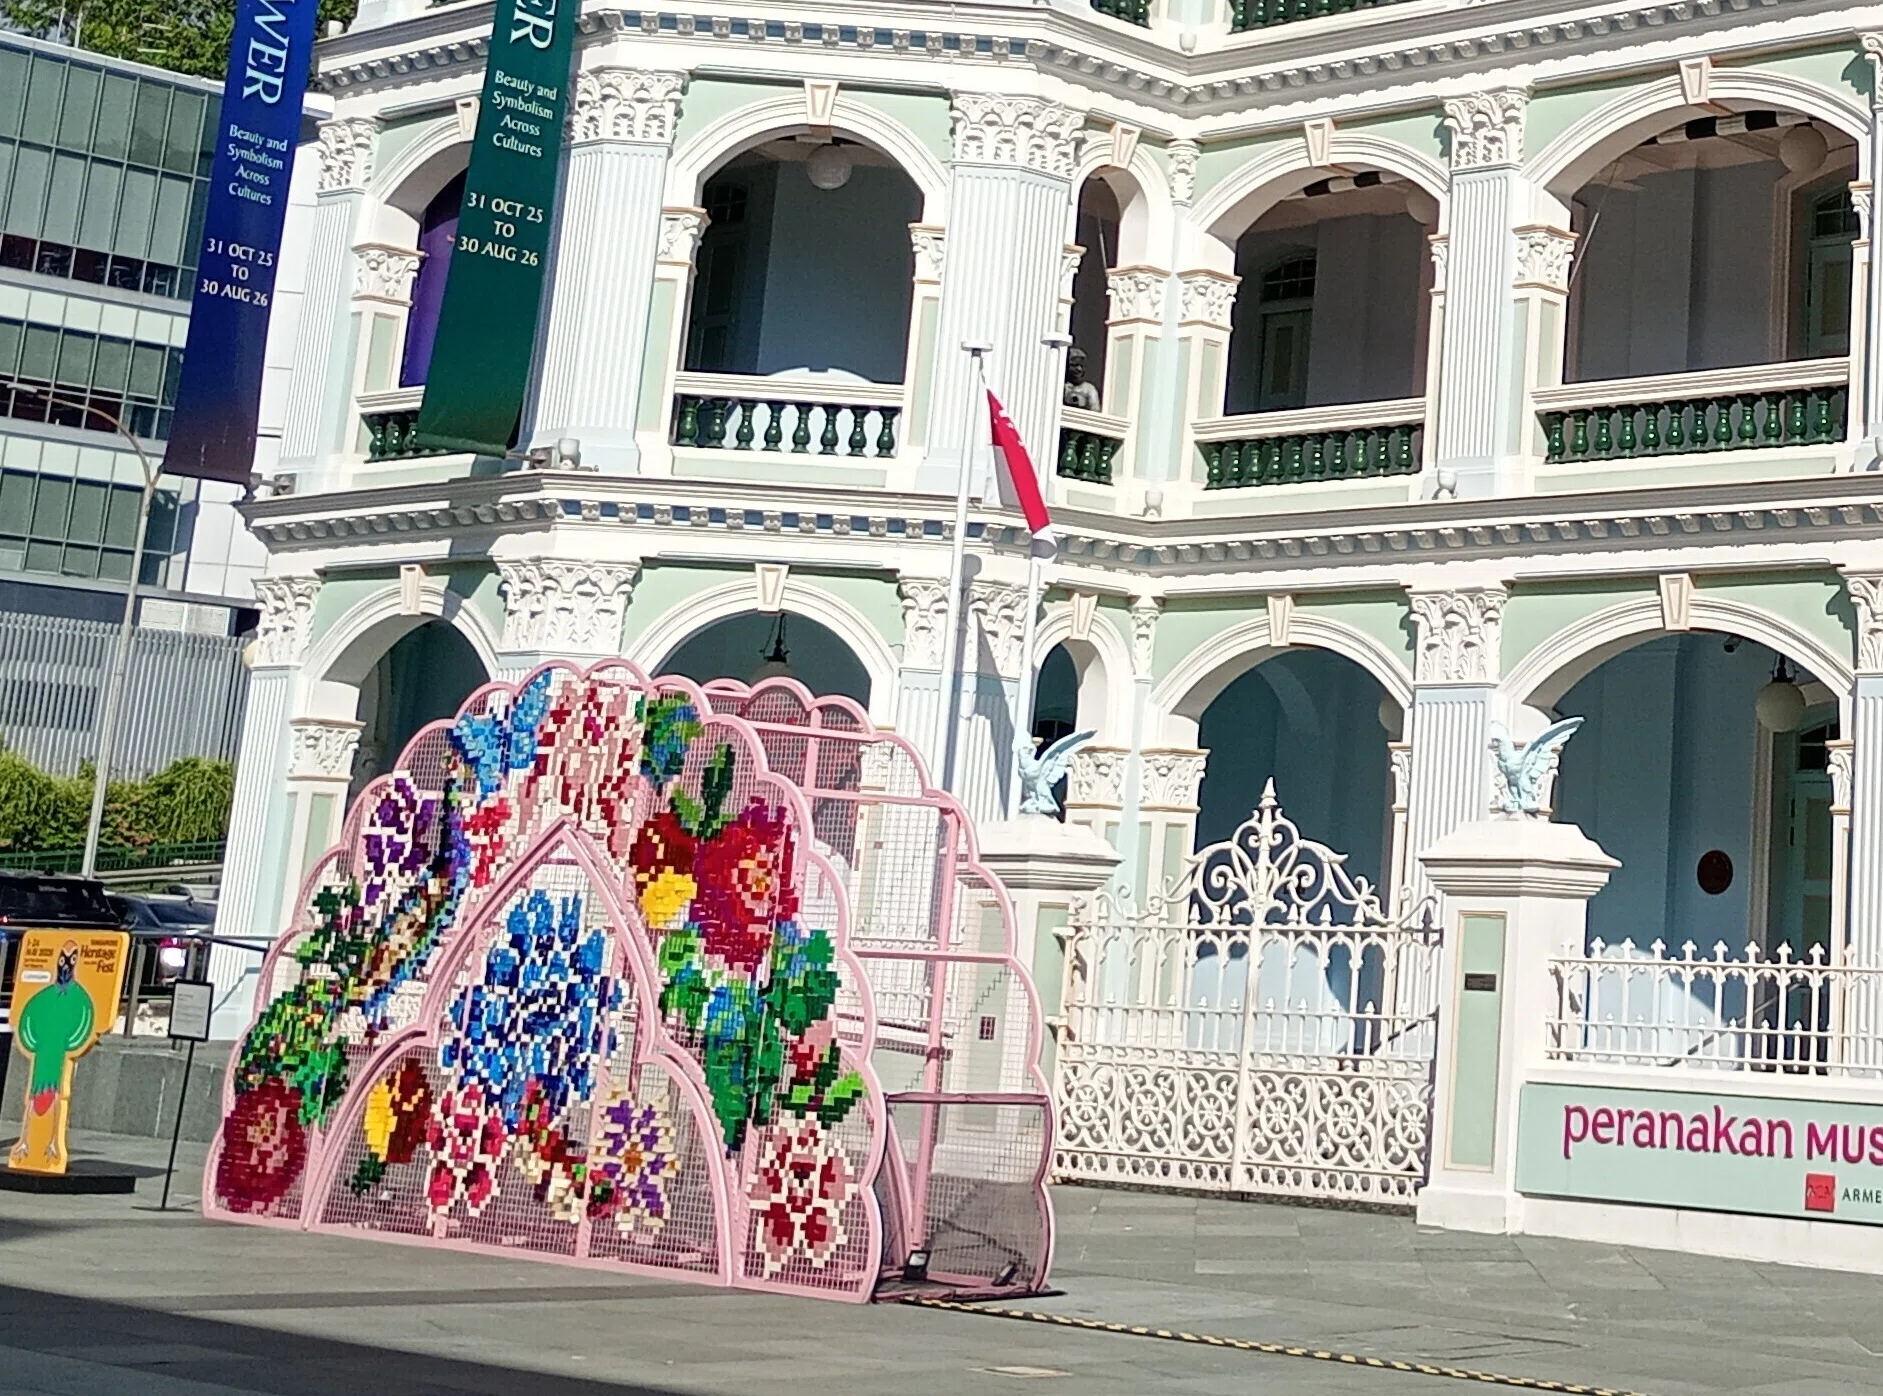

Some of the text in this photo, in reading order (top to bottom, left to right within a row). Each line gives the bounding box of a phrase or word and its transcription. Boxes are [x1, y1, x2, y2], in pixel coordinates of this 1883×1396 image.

[495, 70, 558, 101] Beauty and
[491, 91, 554, 120] Symbolism
[229, 124, 288, 152] Beauty and
[500, 114, 540, 136] Across
[227, 143, 284, 171] Symbolism
[492, 132, 543, 158] Cultures
[235, 163, 270, 185] Across
[228, 182, 272, 205] Cultures
[467, 192, 544, 224] 31 OCT 25
[494, 220, 515, 238] TO
[207, 238, 274, 267] 31 OCT 25
[458, 236, 539, 267] 30 AUG 26
[231, 264, 249, 281] TO
[200, 279, 269, 307] 30 AUG 26
[1562, 1103, 1794, 1160] peranakan
